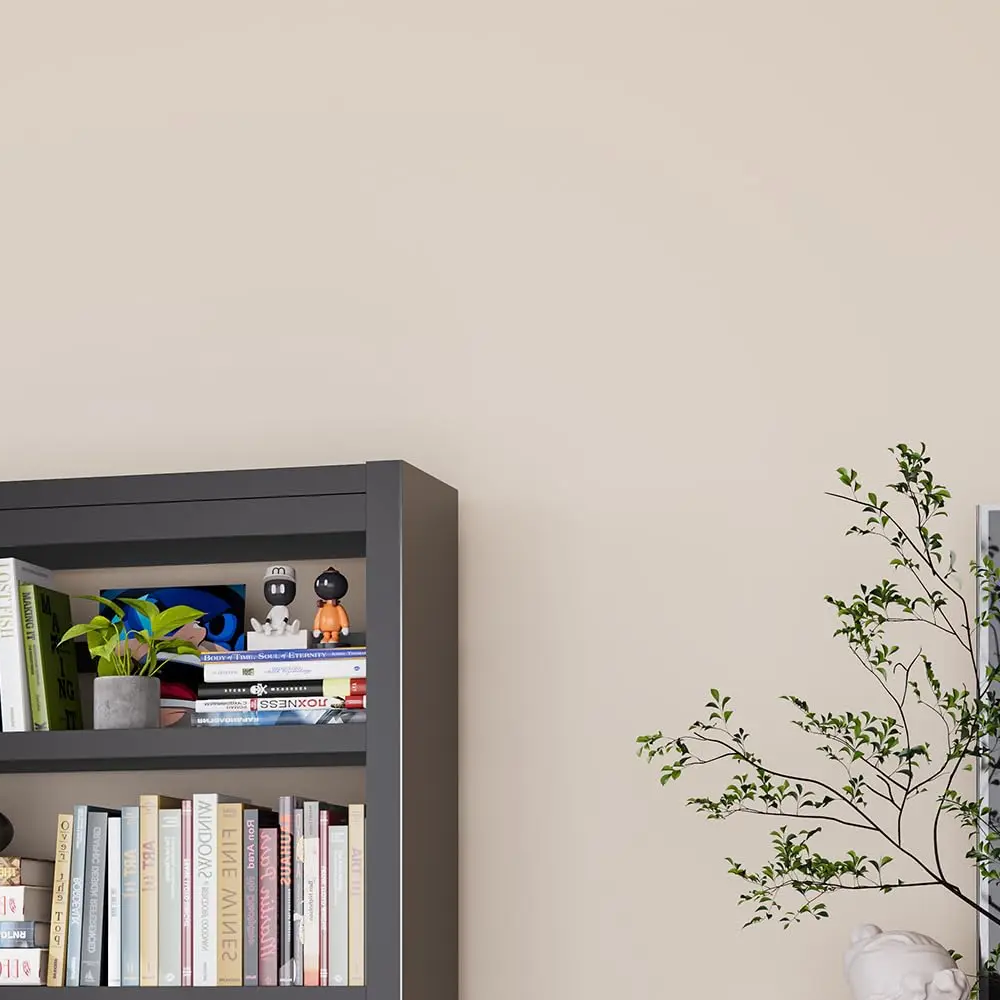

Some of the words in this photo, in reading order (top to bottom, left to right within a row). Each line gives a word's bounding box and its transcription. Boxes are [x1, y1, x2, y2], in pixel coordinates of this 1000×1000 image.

[23, 592, 34, 629] MAKING
[0, 606, 14, 638] FISH
[27, 631, 35, 640] IT
[260, 699, 328, 708] ЛОХNESS
